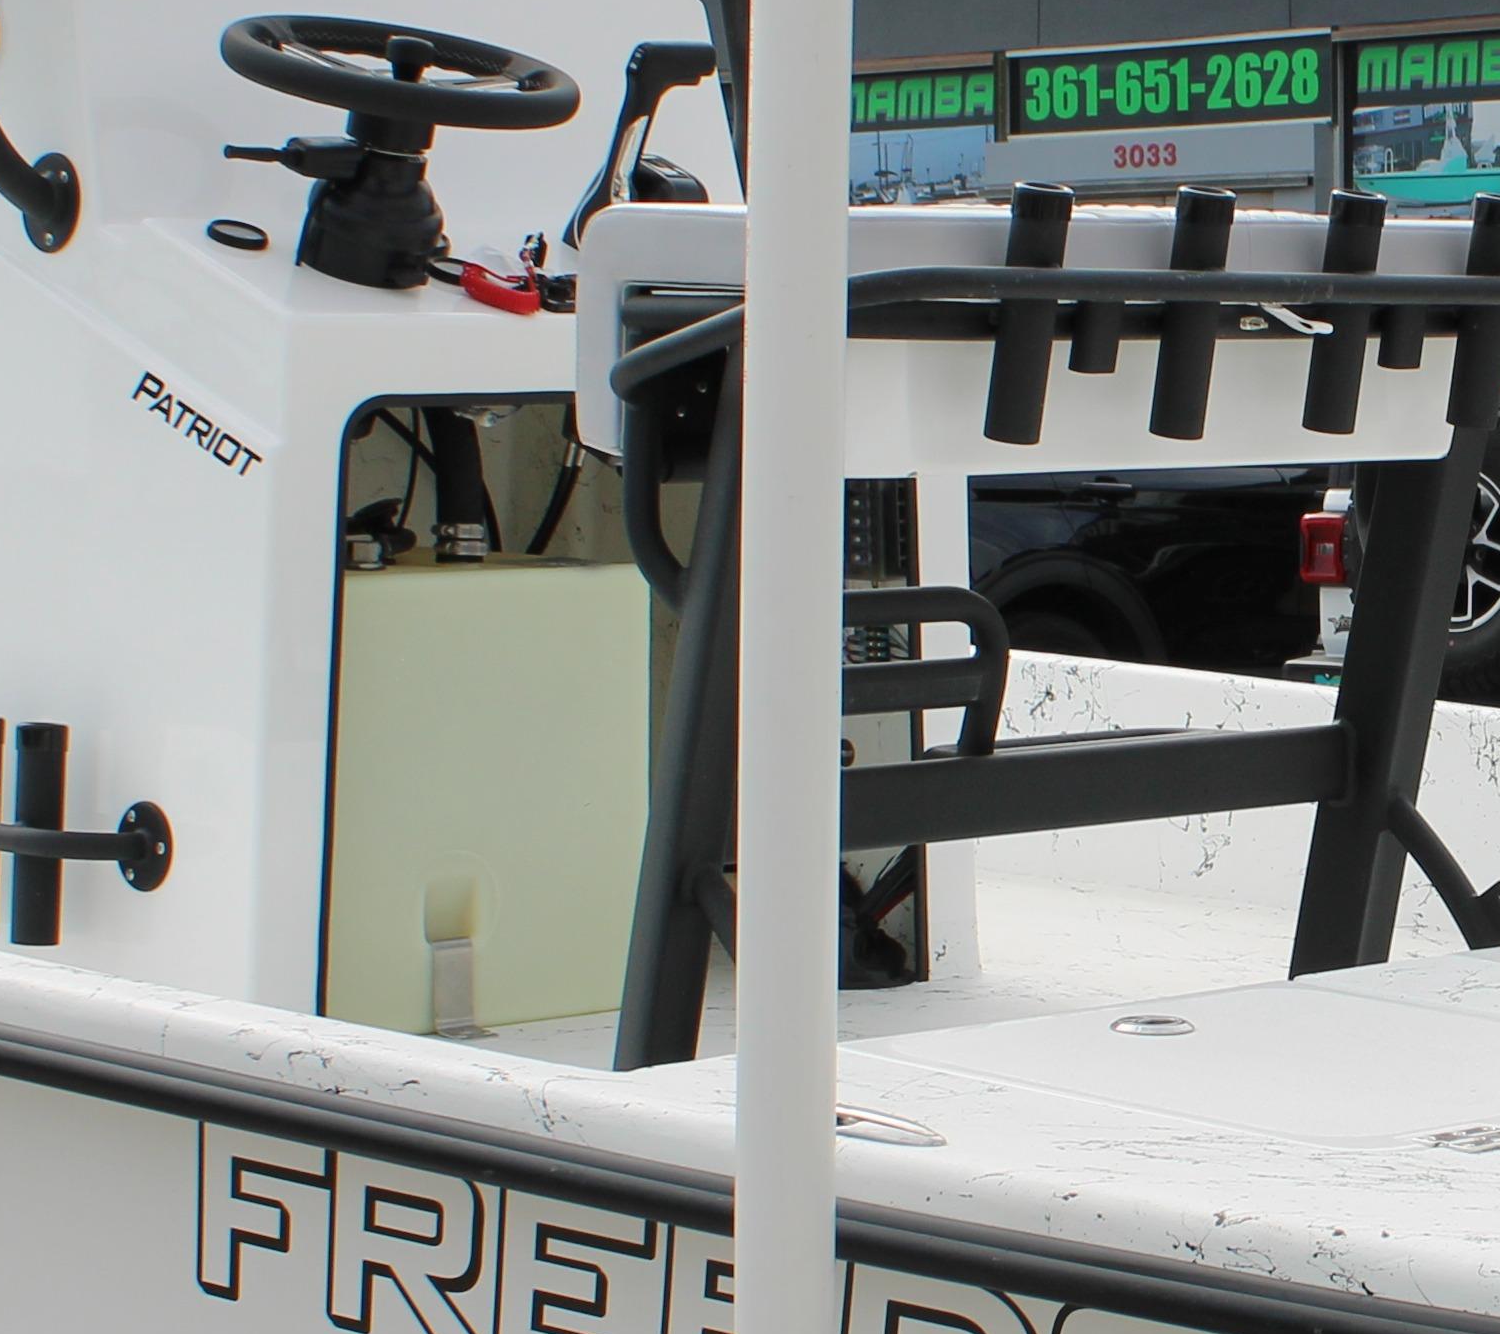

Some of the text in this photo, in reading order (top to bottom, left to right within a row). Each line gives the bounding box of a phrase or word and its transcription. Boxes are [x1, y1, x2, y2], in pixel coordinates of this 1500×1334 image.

[1025, 48, 1319, 122] 361-651-2628
[1113, 143, 1177, 168] 3033
[131, 370, 262, 476] PATRIOT
